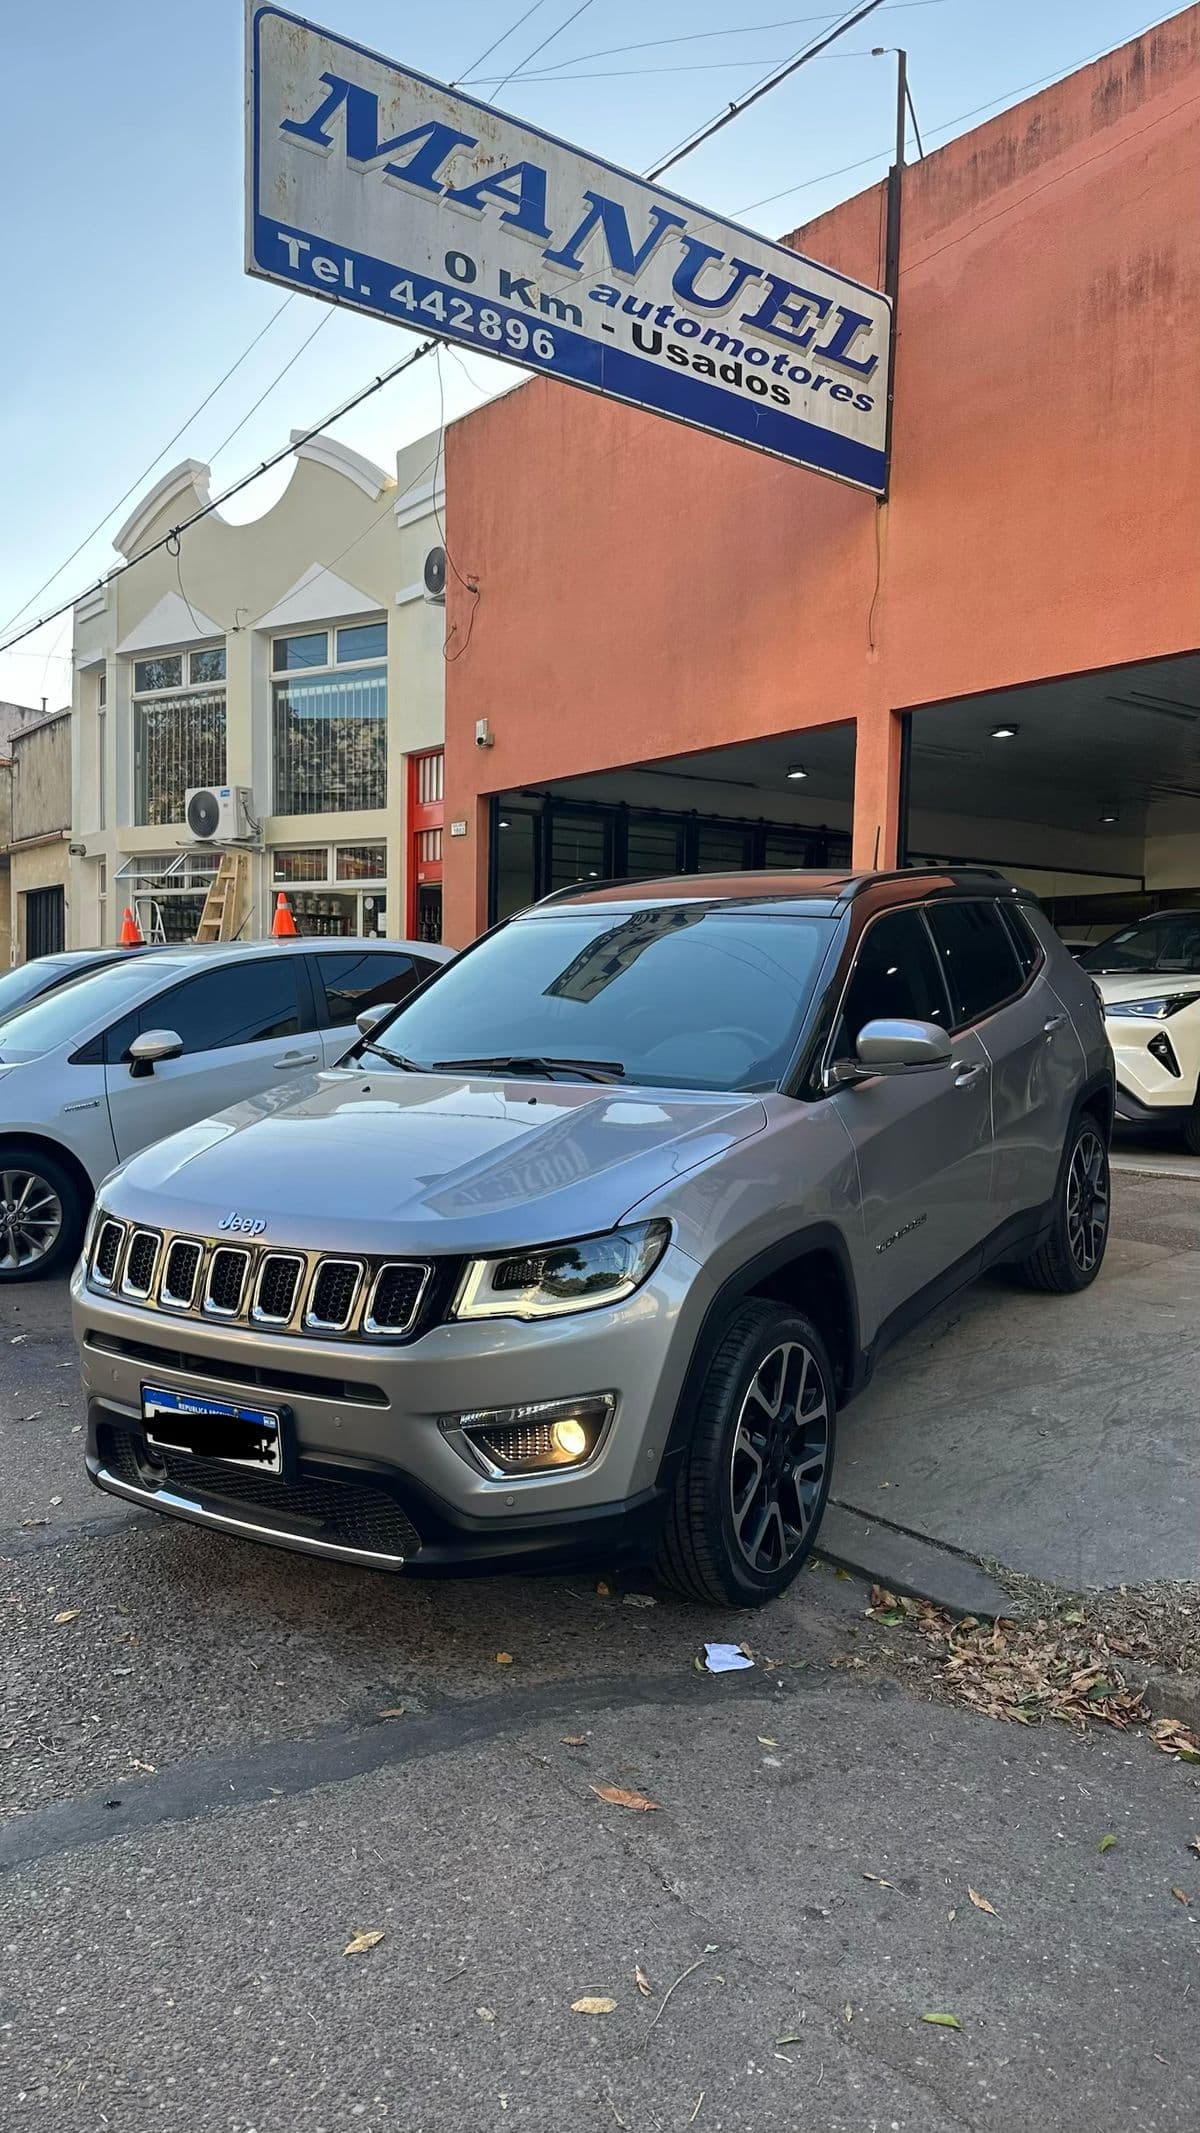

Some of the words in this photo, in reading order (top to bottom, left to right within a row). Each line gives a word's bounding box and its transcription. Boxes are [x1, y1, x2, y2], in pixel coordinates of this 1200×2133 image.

[279, 72, 879, 380] MANUEL
[277, 232, 371, 296] Tel.
[390, 279, 556, 360] 442896
[499, 268, 583, 327] Km
[632, 323, 791, 406] Usados
[588, 283, 876, 412] automotores
[218, 1211, 267, 1237] Jeep
